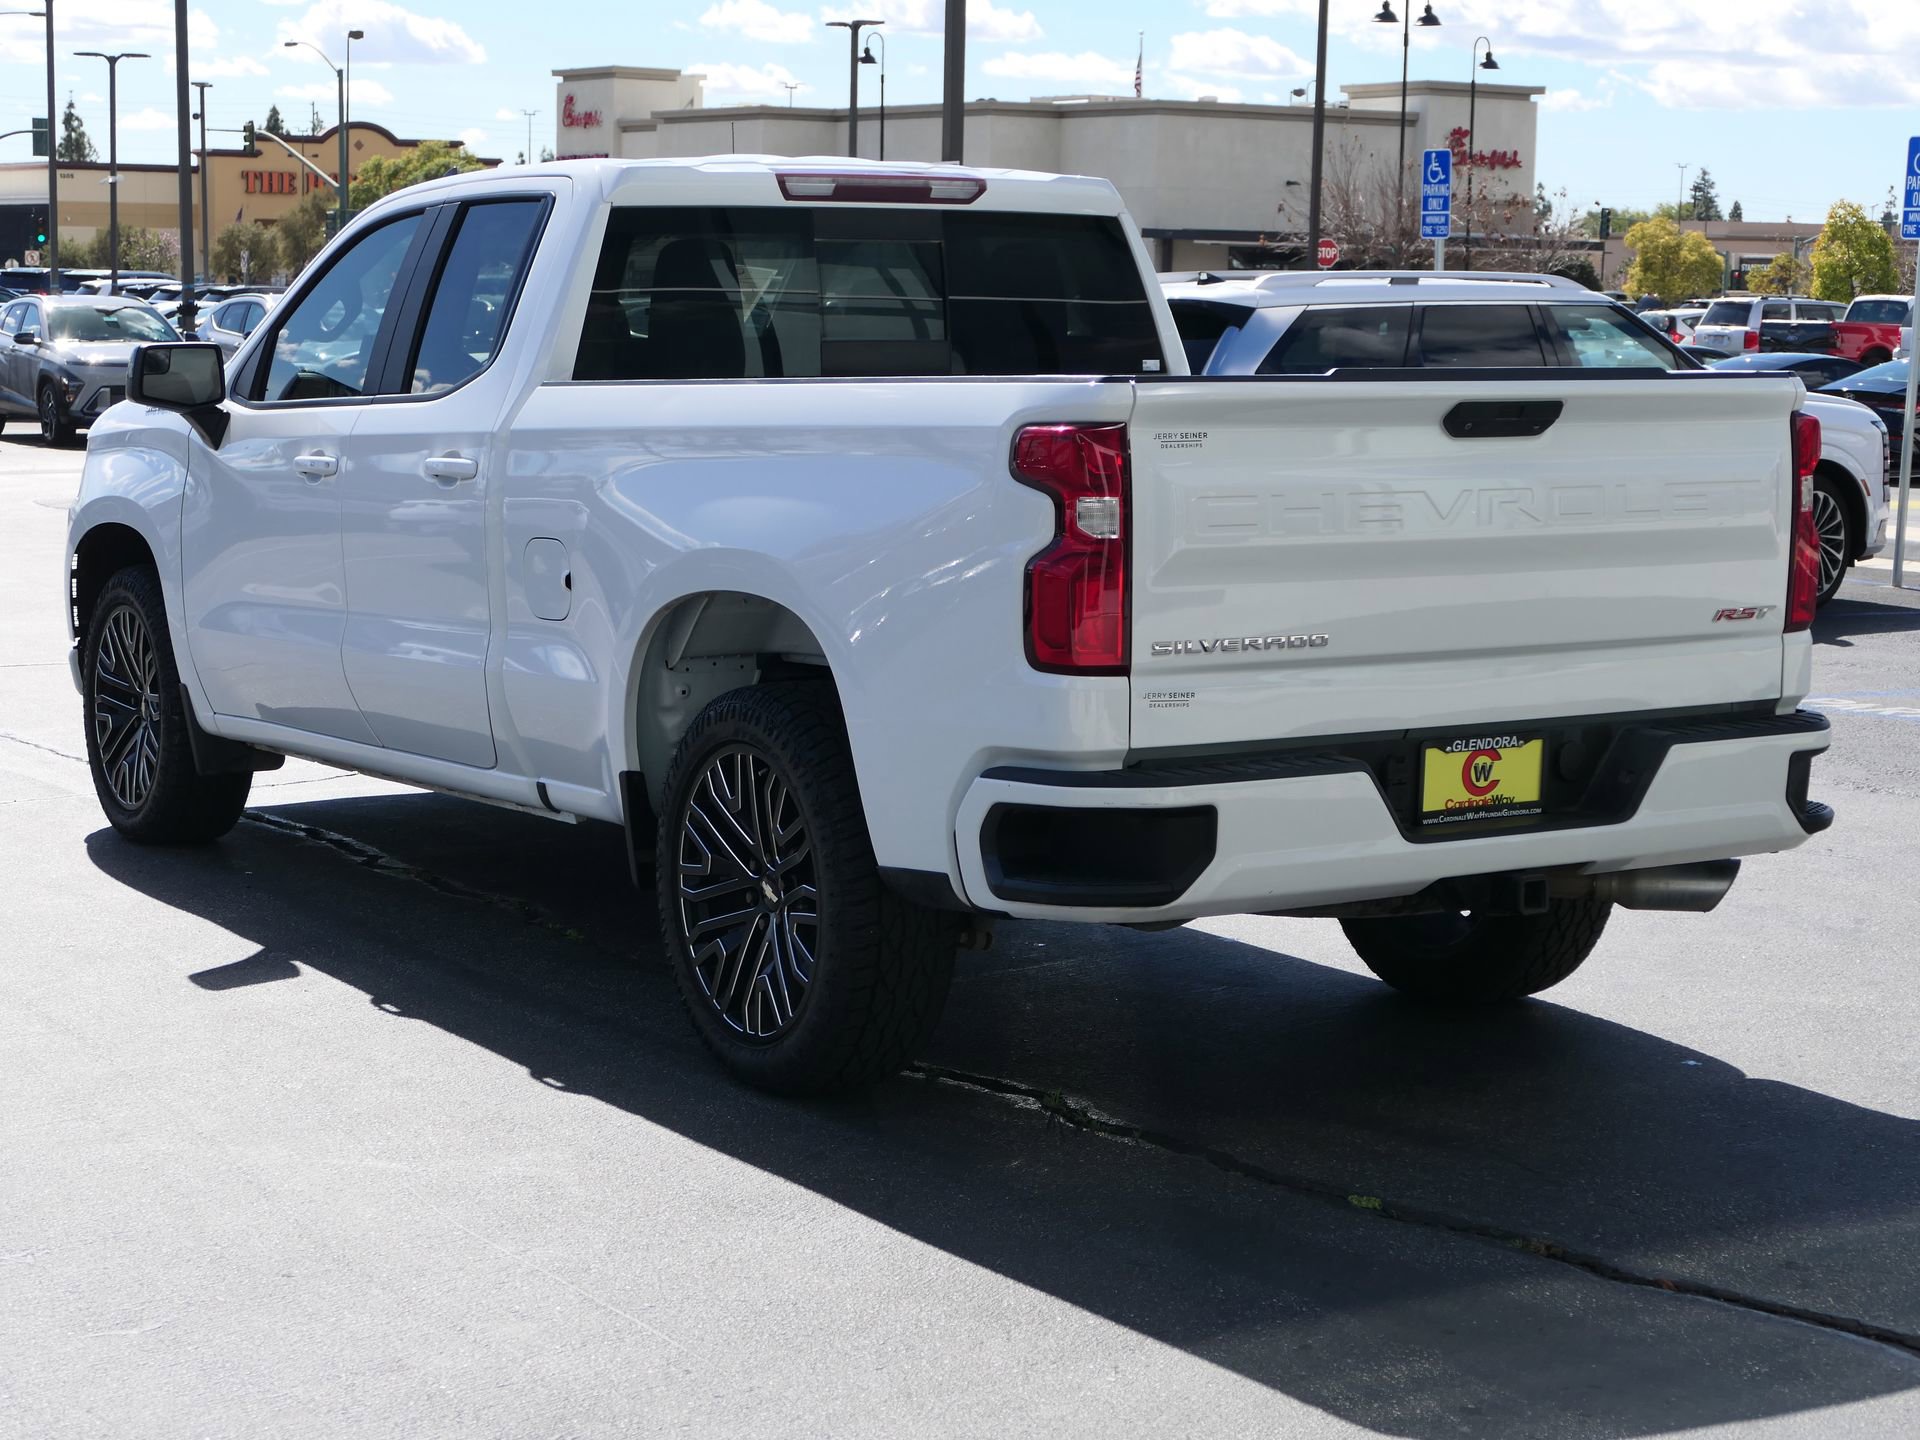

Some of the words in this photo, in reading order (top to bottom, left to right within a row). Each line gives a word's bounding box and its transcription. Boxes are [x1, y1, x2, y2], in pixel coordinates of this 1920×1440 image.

[241, 170, 297, 194] THE
[1423, 183, 1449, 197] PARKING
[1427, 197, 1444, 210] ONLY
[1903, 224, 1917, 234] FINE
[1317, 247, 1337, 259] STOP
[1153, 432, 1179, 440] JERRY
[1179, 432, 1208, 440] SEINER
[1711, 605, 1777, 623] RST
[1151, 632, 1329, 657] SILVERADO
[1143, 692, 1167, 700] JERRY
[1168, 692, 1195, 700] SEINER
[1452, 736, 1518, 751] GLENDORA
